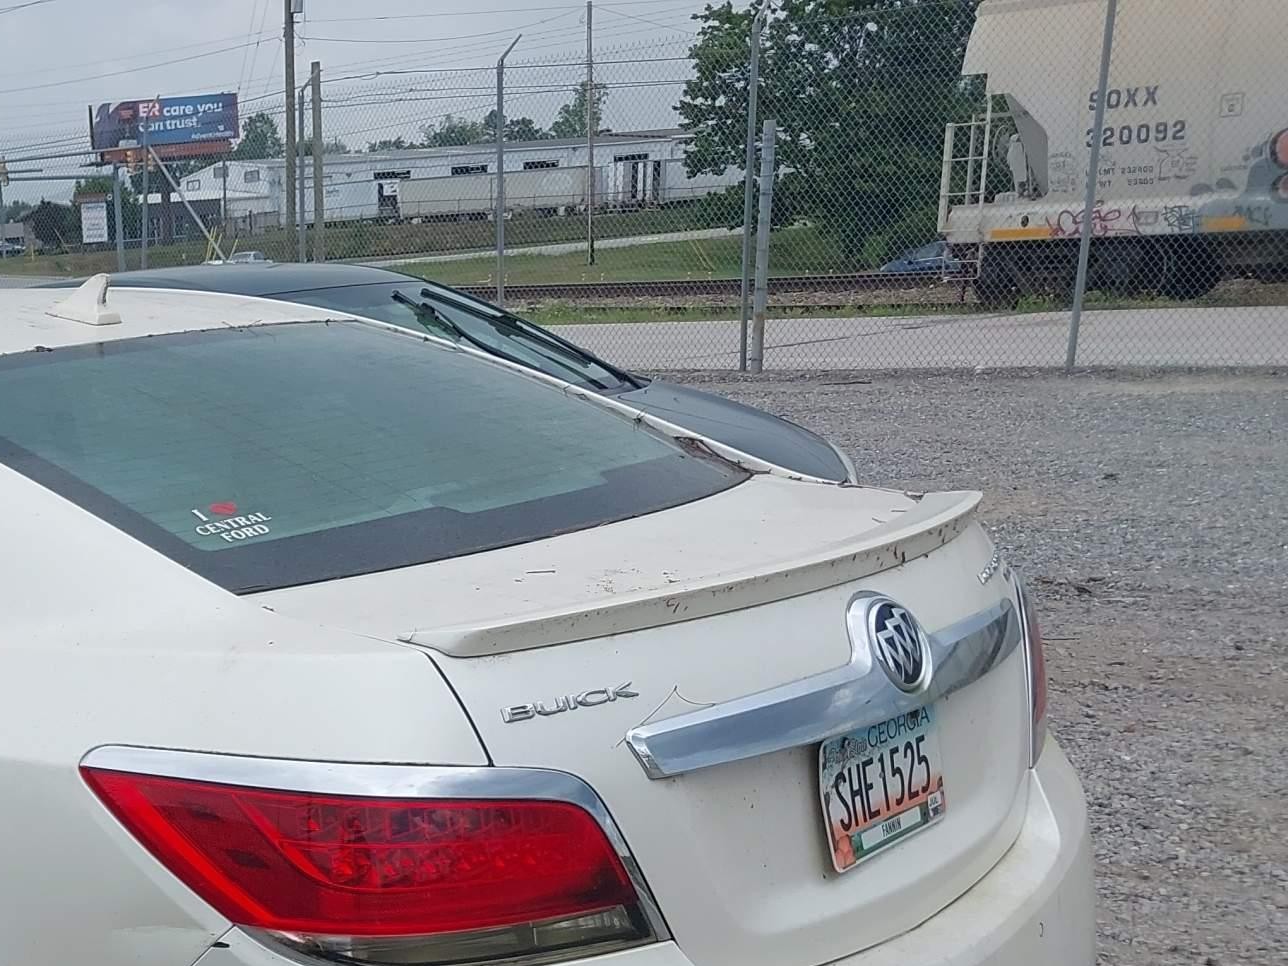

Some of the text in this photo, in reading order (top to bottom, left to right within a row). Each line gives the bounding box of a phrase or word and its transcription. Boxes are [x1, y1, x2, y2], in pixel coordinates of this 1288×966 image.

[138, 103, 160, 117] ER
[163, 105, 193, 116] care
[197, 102, 223, 116] you
[138, 119, 164, 132] can
[191, 509, 209, 521] I
[195, 512, 272, 535] CENTRAL
[220, 524, 270, 542] FORD
[500, 681, 640, 723] BUICK
[867, 707, 930, 748] GEORGIA
[834, 735, 931, 832] SHE1525
